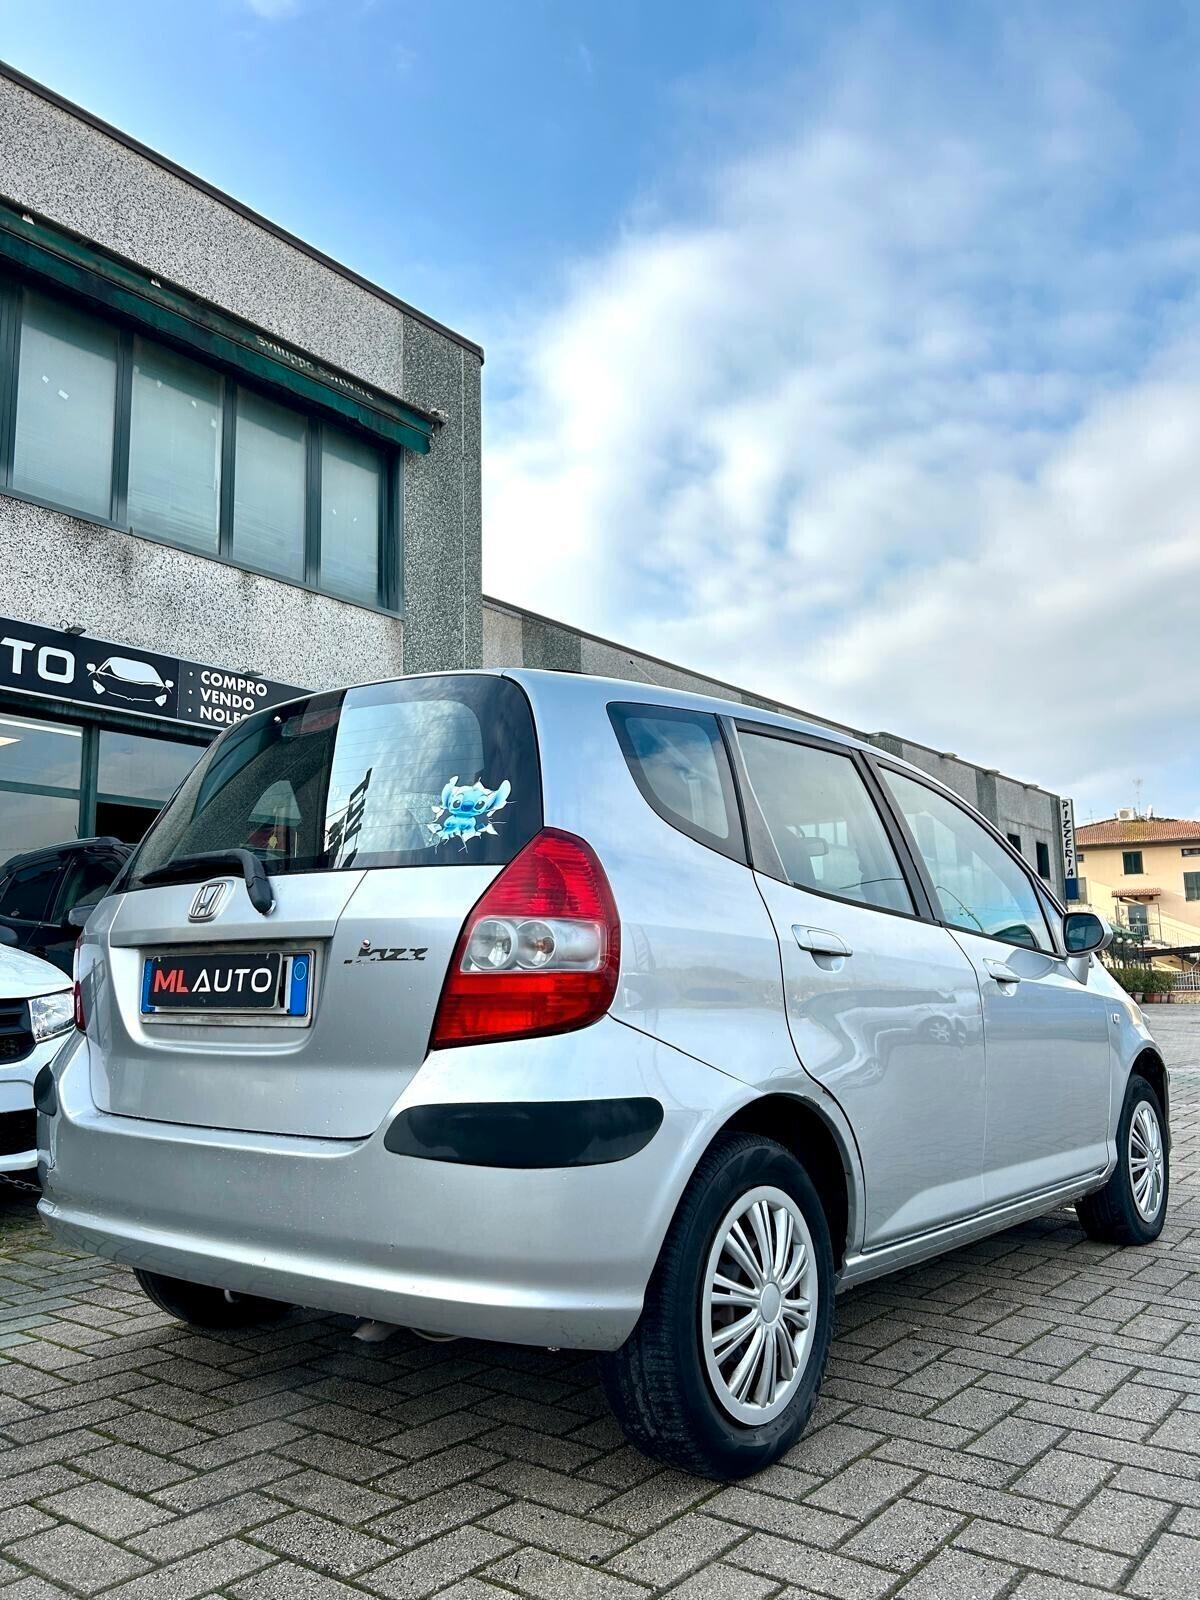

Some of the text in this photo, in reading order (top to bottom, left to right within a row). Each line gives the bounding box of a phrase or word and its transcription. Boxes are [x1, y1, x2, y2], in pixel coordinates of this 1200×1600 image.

[0, 637, 75, 684] TO
[200, 670, 268, 697] COMPRO
[200, 687, 255, 711] VENDO
[1061, 800, 1075, 878] PIZZERIA
[153, 967, 273, 993] ML AUTO
